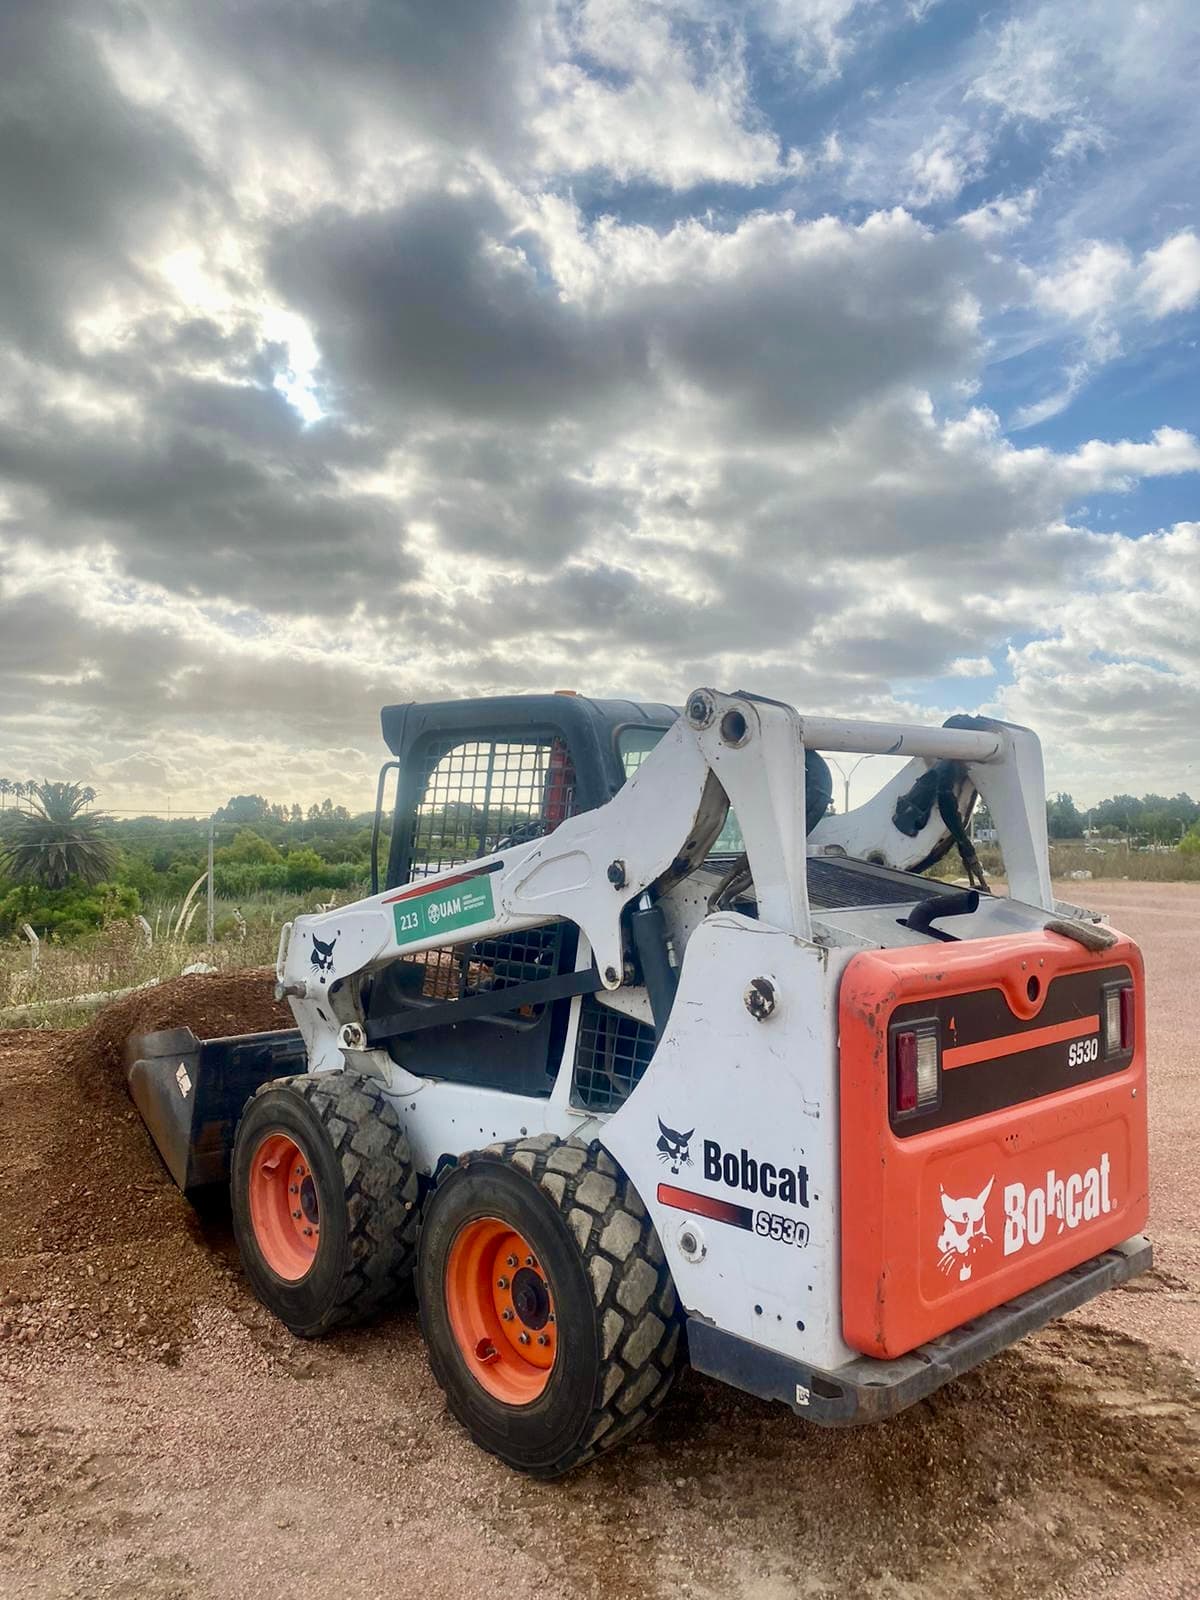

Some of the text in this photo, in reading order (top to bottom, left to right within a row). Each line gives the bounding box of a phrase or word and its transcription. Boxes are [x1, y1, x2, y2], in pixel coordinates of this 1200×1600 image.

[400, 912, 419, 931] 213
[439, 898, 462, 918] UAM
[1068, 1038, 1098, 1067] S530
[704, 1139, 810, 1209] Bobcat
[1003, 1152, 1111, 1256] Bobcat
[756, 1210, 810, 1249] S530
